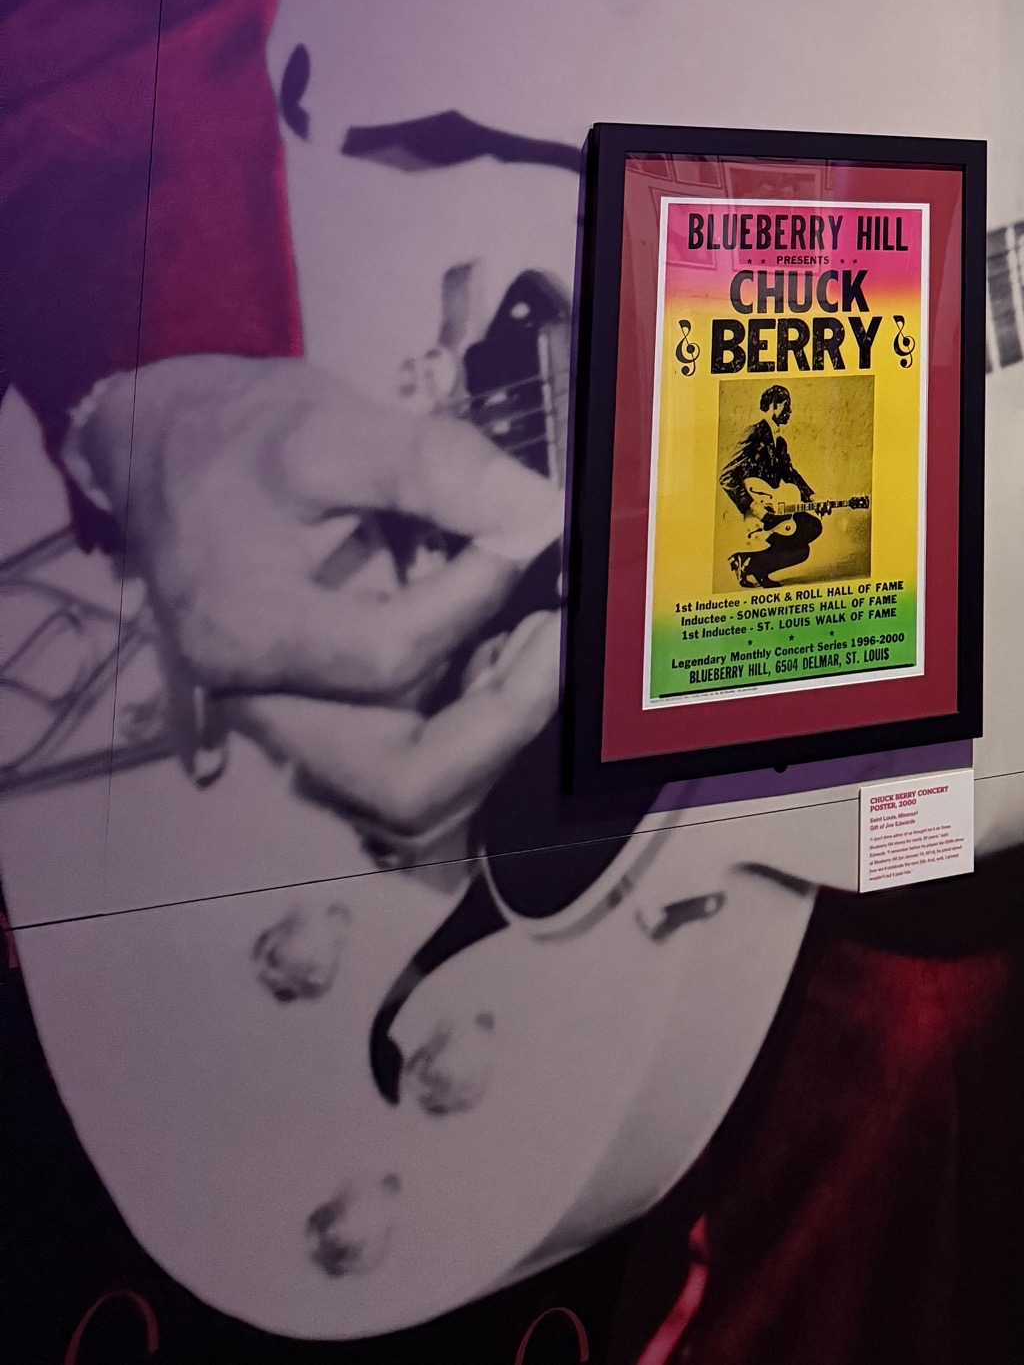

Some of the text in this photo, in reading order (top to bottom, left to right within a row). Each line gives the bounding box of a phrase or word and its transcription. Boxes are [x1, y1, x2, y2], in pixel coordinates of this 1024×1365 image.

[688, 213, 908, 251] BLUEBERRY HILL
[776, 255, 830, 265] PRESENTS
[729, 269, 870, 315] CHUCK
[710, 316, 882, 375] BERRY
[675, 581, 903, 613] 1st Inductee ROCK & ROLL HALL OF FAME
[681, 595, 897, 626] Inductee SONGWRITERS HALL OF FAME
[682, 608, 896, 640] 1st Inductee ST. LOUIS WALK OF FAME
[672, 633, 905, 669] Legendary Monthly Concert Series 1996-2000
[689, 648, 889, 684] BLUEBERRY HILL, 6504 DELMAR, ST. LOUIS
[870, 786, 949, 804] CHUCK BERRY CONCERT
[870, 799, 916, 812] POSTER, 2000
